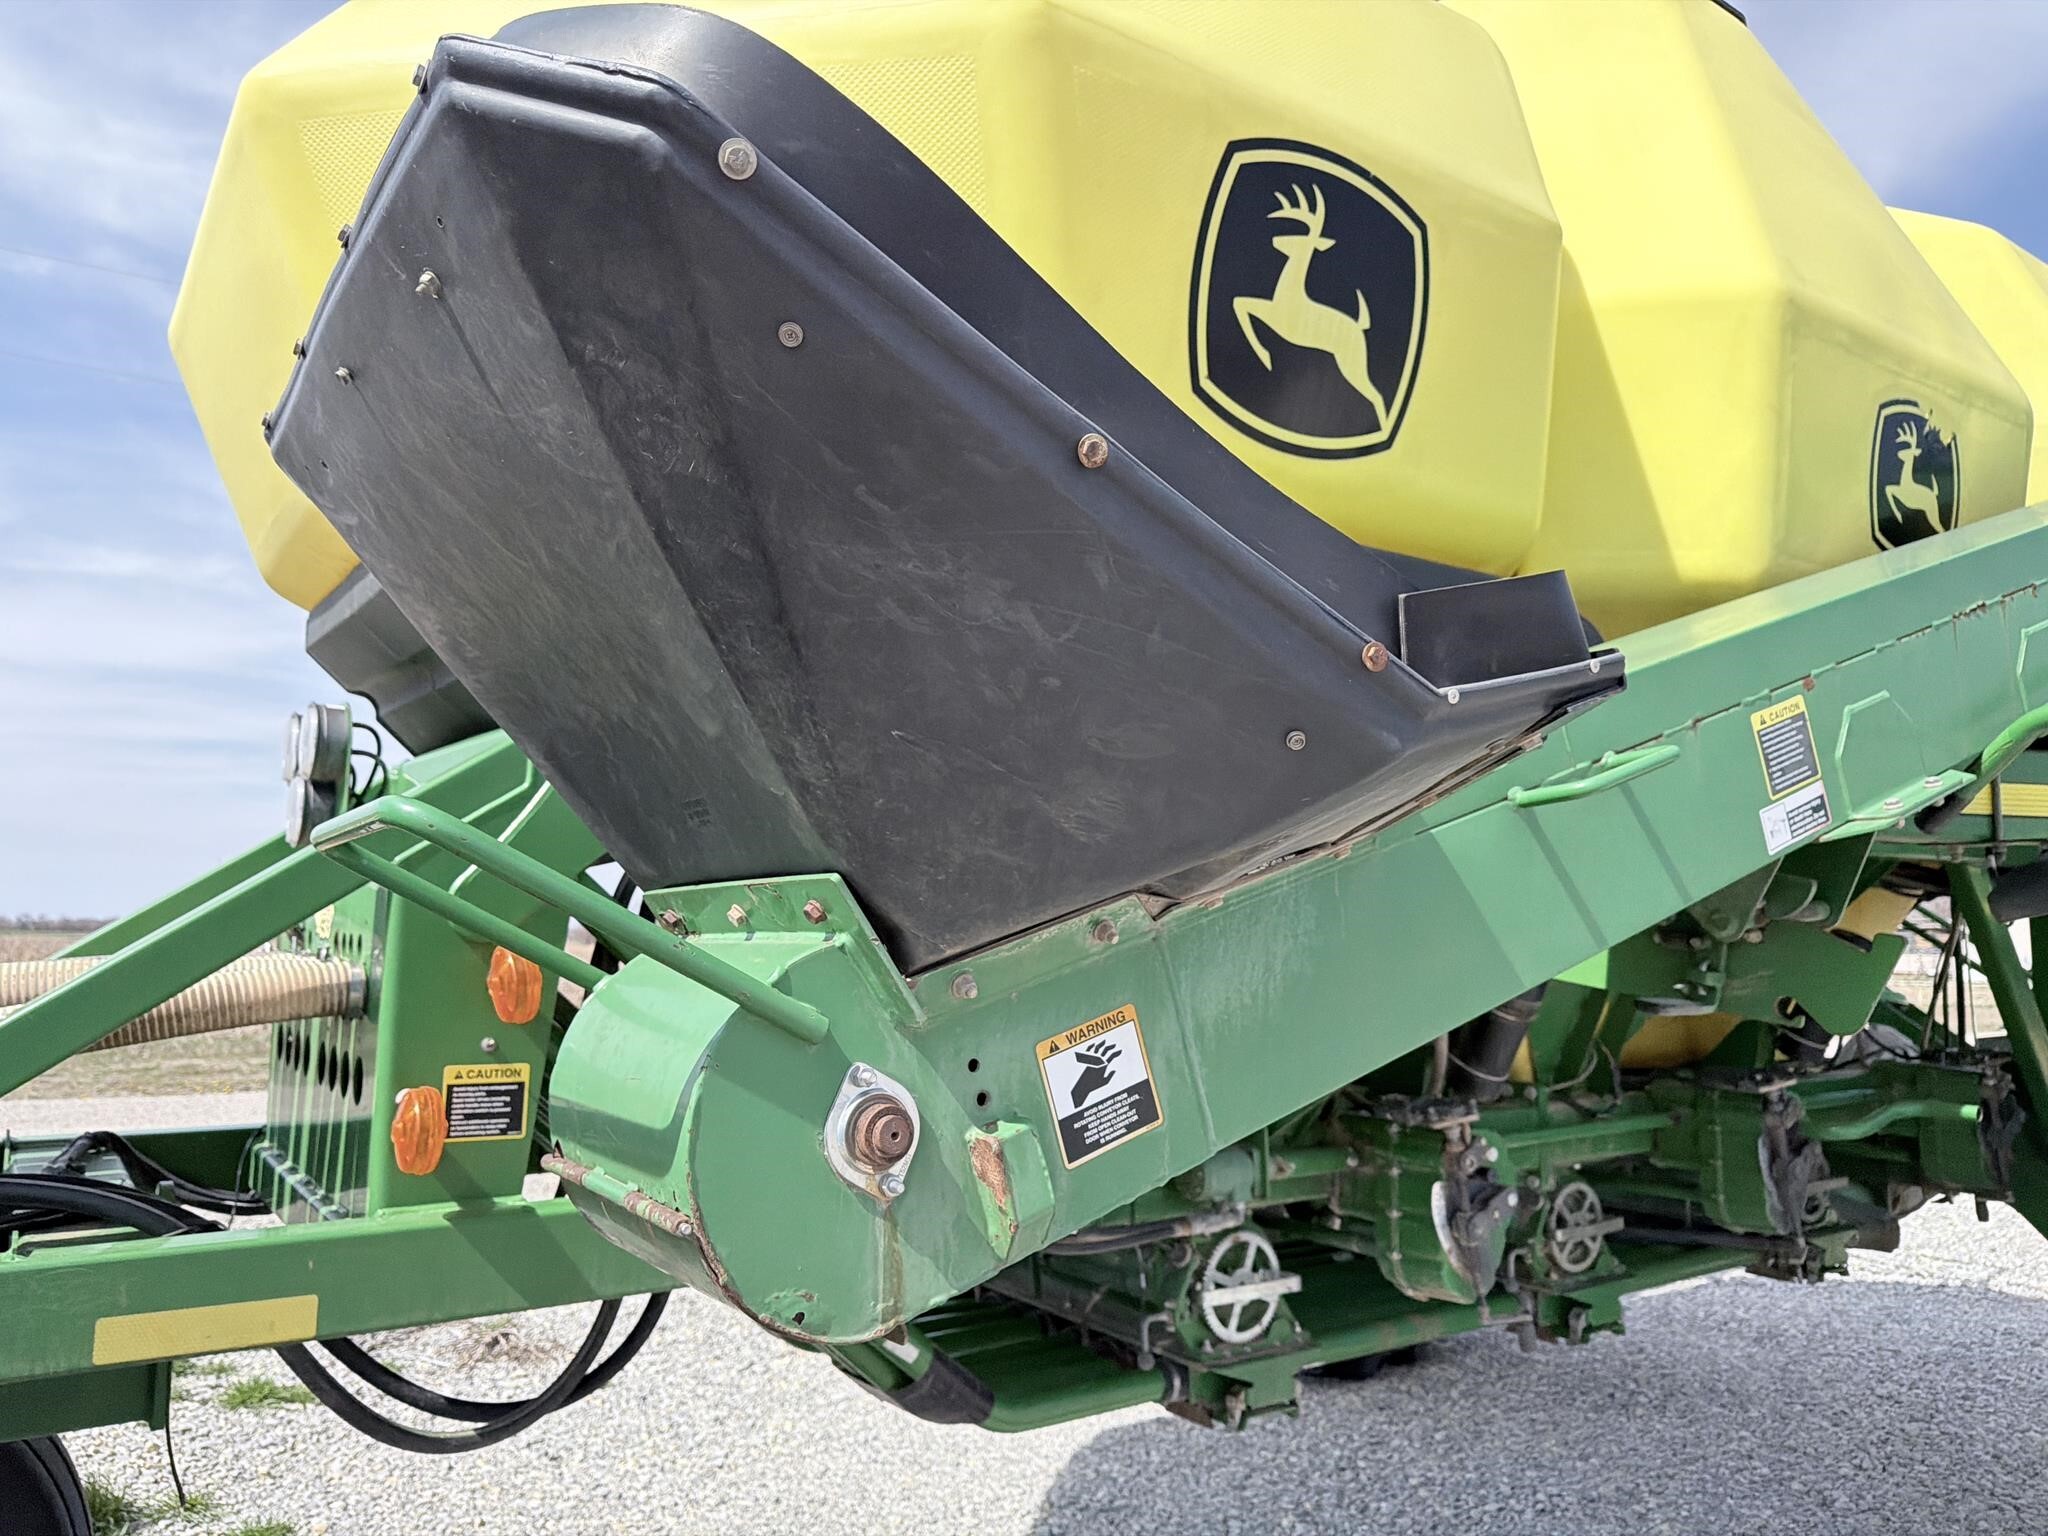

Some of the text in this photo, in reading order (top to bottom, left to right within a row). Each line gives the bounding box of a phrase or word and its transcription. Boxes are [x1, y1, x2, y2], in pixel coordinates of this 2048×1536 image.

[1769, 702, 1801, 722] CAUTION
[1065, 1010, 1126, 1045] WARNING
[467, 1068, 522, 1080] CAUTION
[1073, 1114, 1097, 1129] ROTATING
[1096, 1102, 1122, 1118] CONVEYOR
[1083, 1107, 1098, 1117] AVOID
[1114, 1092, 1128, 1103] FROM
[1083, 1128, 1098, 1138] FROM
[1098, 1121, 1111, 1131] OPEN
[1088, 1119, 1101, 1129] KEEP
[1099, 1127, 1113, 1139] WHEN
[1113, 1114, 1139, 1130] CONVEYOR
